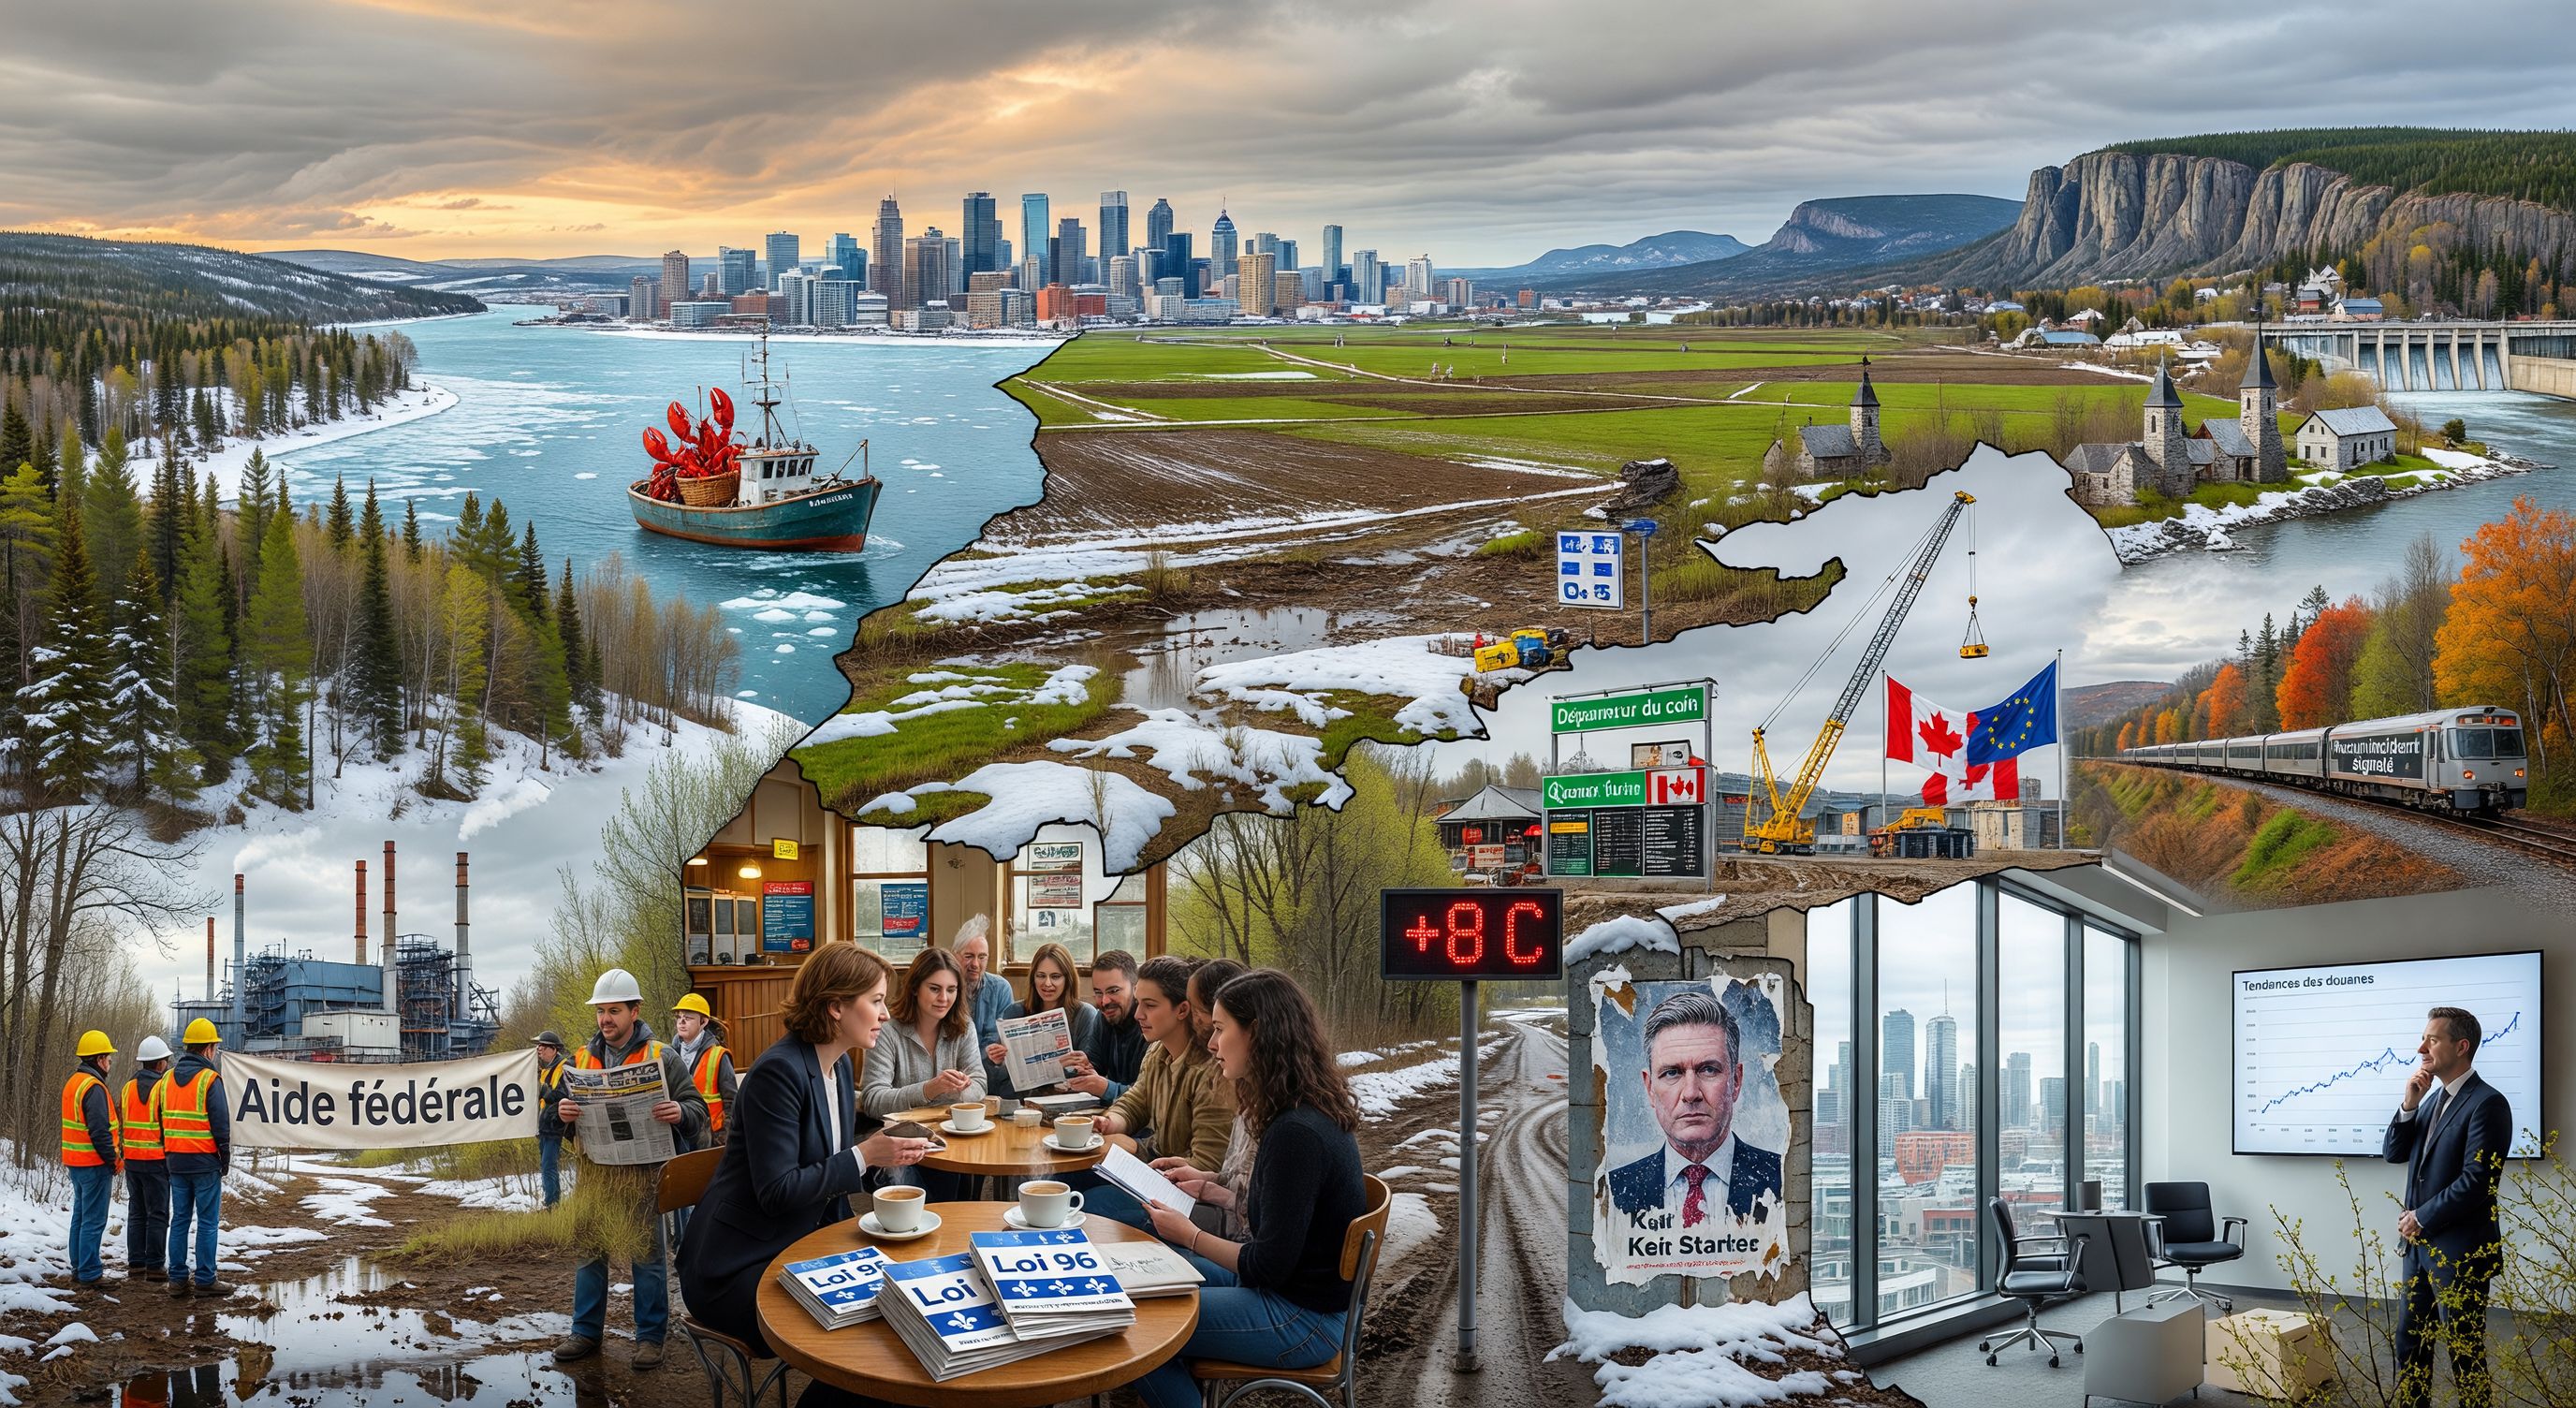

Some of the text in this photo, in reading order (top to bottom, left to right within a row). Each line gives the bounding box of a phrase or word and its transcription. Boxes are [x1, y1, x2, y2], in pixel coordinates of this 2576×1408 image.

[1643, 698, 1661, 715] du
[1666, 696, 1698, 713] coin
[1506, 902, 1544, 963] C
[2243, 975, 2375, 991] Tendances des douanes
[236, 1078, 335, 1125] Aide
[348, 1074, 525, 1126] fédérale
[991, 1253, 1049, 1273] Loi
[1053, 1251, 1098, 1271] 96
[808, 1269, 856, 1288] Loi
[912, 1278, 978, 1307] Loi
